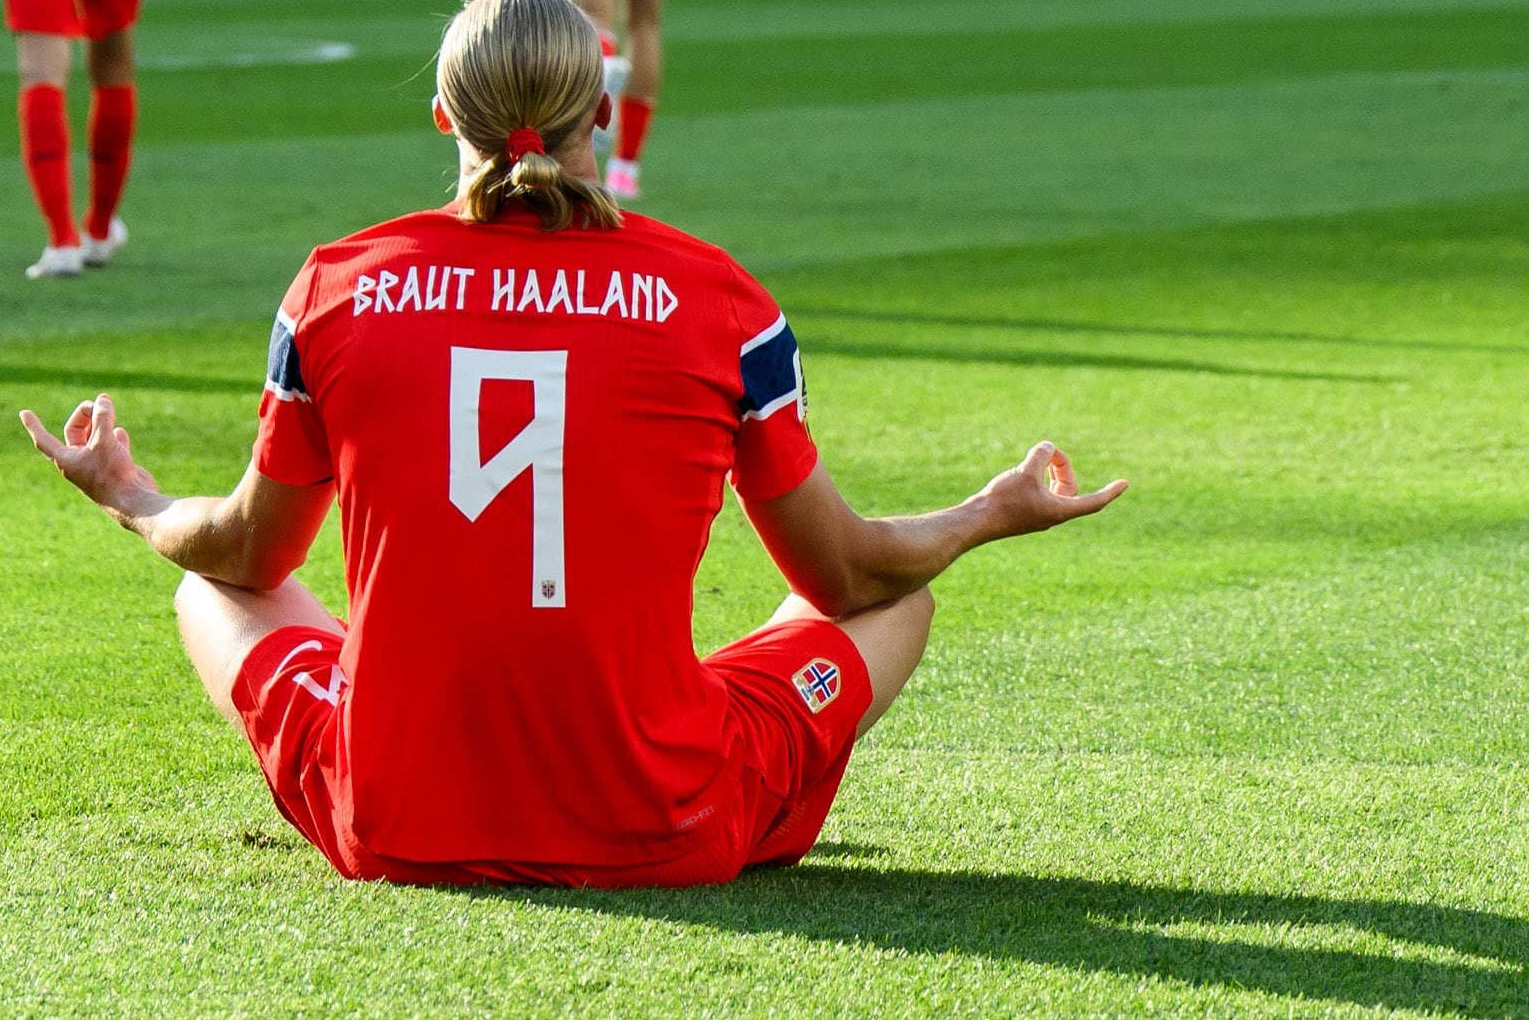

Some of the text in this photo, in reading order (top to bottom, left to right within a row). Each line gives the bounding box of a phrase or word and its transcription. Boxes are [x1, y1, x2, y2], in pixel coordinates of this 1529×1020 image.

[353, 265, 679, 323] BRAUT HAALAND
[448, 344, 569, 609] 9
